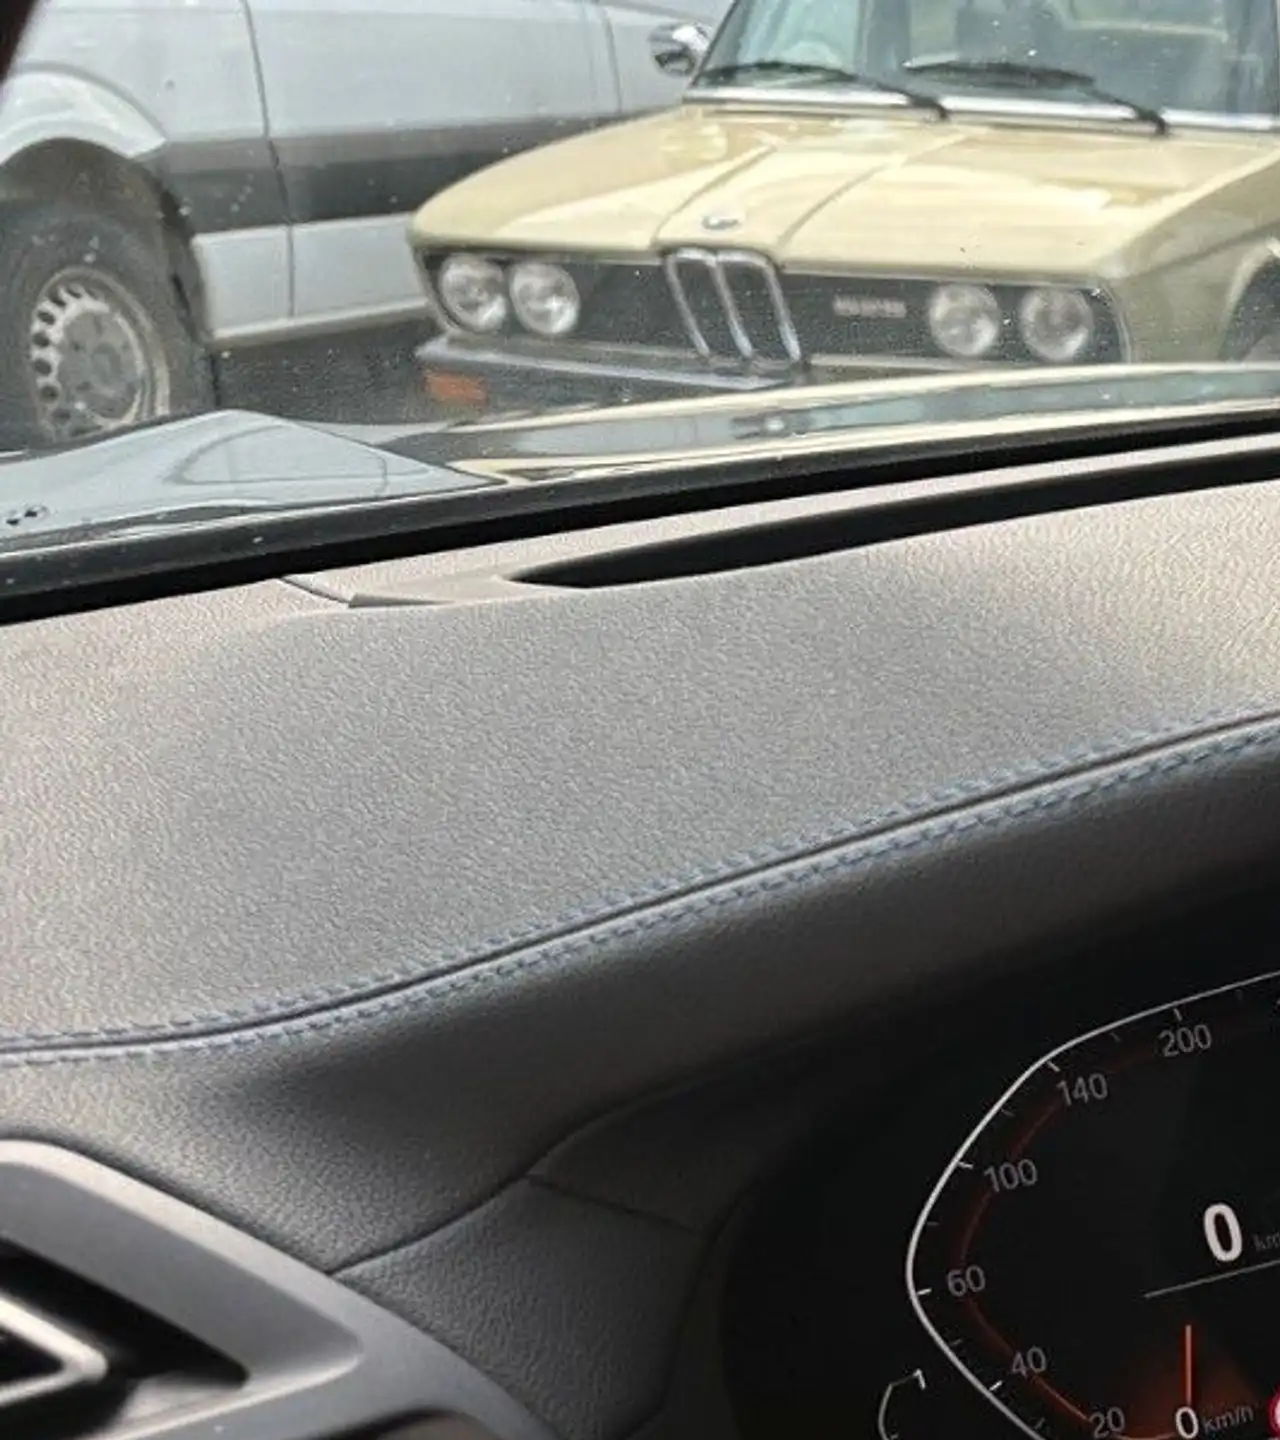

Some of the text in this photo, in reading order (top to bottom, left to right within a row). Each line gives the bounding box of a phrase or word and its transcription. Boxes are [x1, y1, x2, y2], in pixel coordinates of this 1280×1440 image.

[1158, 1023, 1213, 1058] 200
[1056, 1072, 1109, 1106] 140
[983, 1158, 1039, 1193] 100
[1203, 1201, 1243, 1263] 0
[945, 1265, 986, 1298] 60
[913, 1367, 927, 1390] 1
[1011, 1346, 1048, 1380] 40
[1089, 1406, 1126, 1440] 20
[1174, 1405, 1254, 1440] 0 km/h
